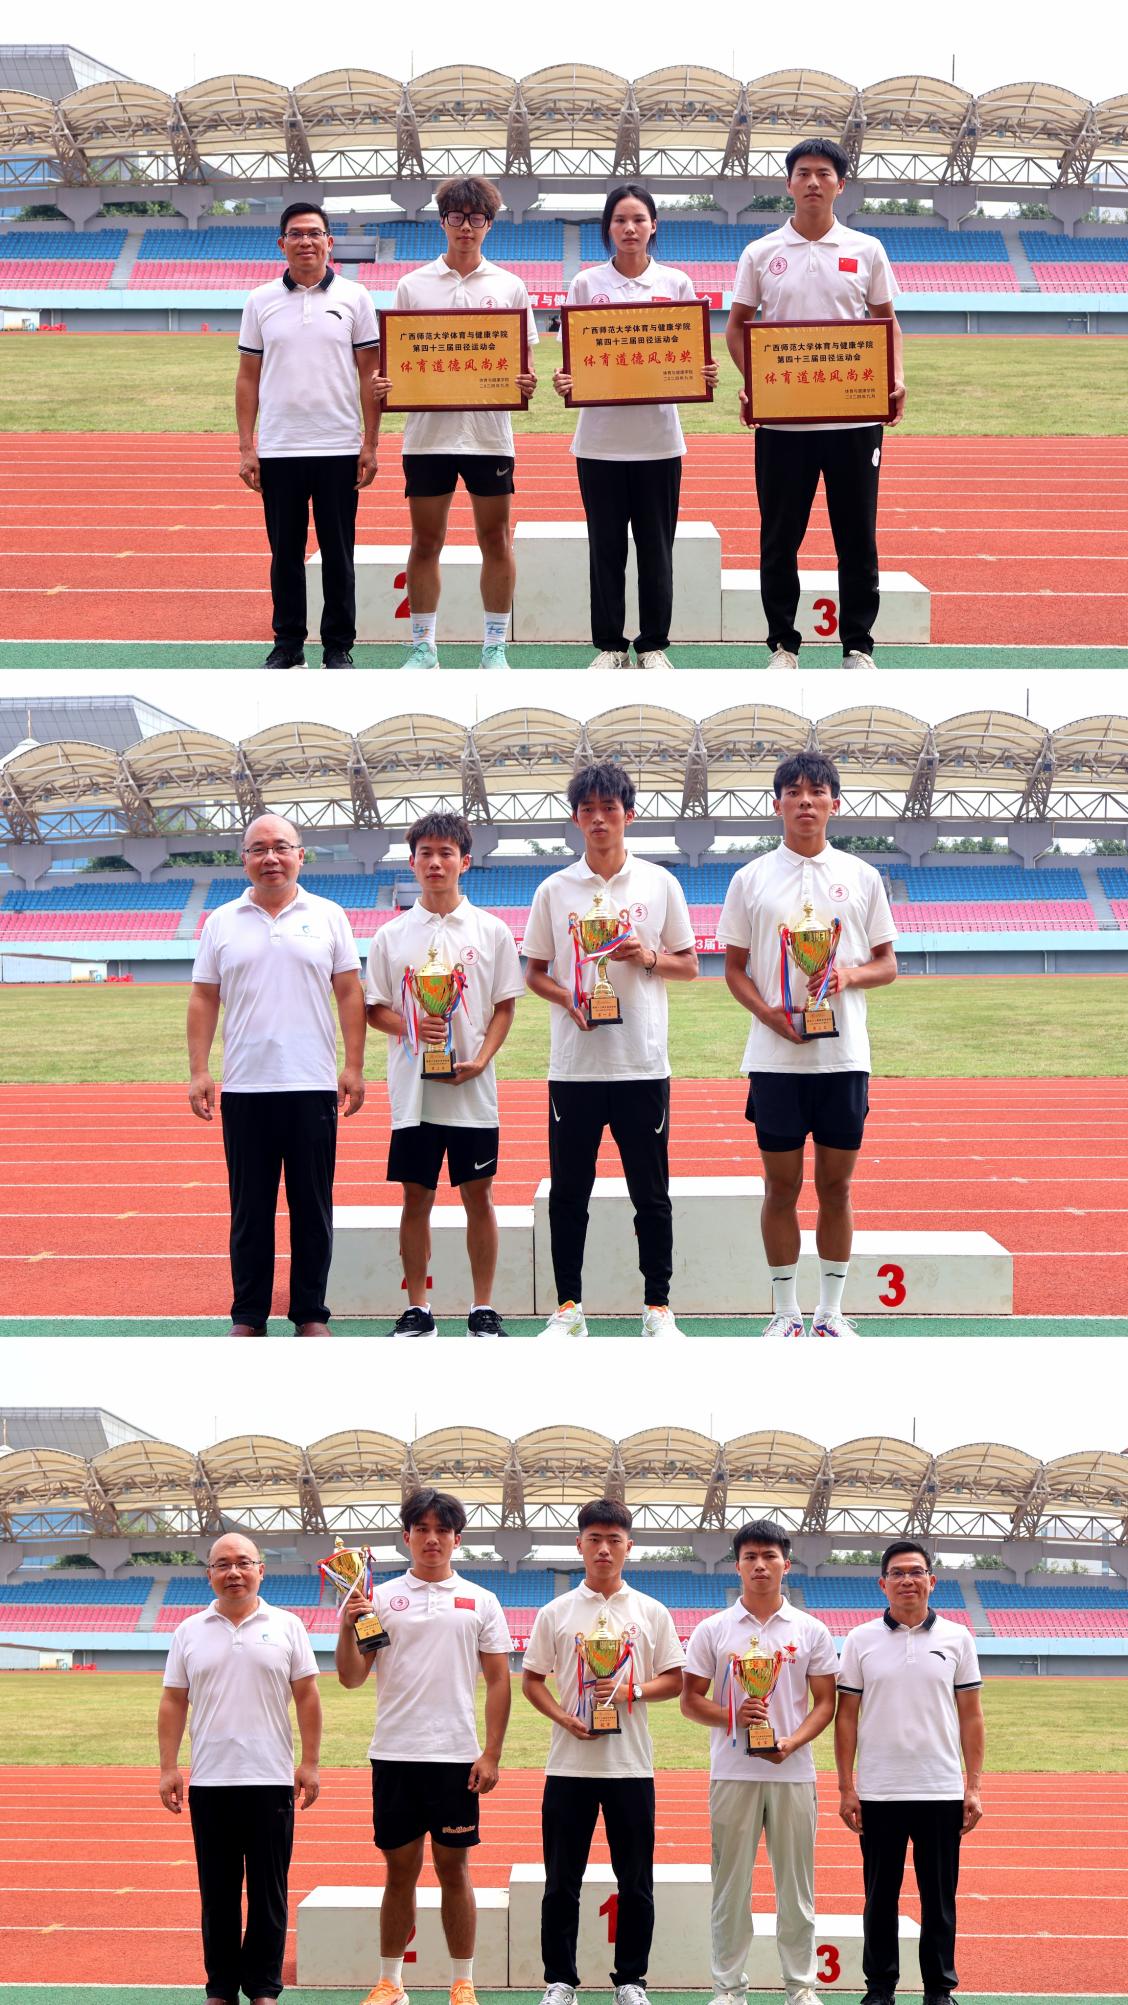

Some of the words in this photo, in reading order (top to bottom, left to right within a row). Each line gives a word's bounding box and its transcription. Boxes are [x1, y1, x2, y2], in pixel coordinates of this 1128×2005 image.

[400, 330, 508, 341] 广西师范大学体育与健康学院
[583, 322, 691, 336] 广西师范大学体育与健康学院
[412, 343, 496, 353] 第四十三届田径运动会
[596, 335, 679, 346] 第四十三届田径运动会
[764, 340, 874, 352] 广西师范大学体育与健康学院
[400, 357, 509, 374] 体育道德风尚奖
[584, 350, 692, 367] 体育道德风尚奖
[777, 353, 862, 364] 第四十三届田径运动会
[764, 367, 875, 385] 体育道德风尚奖
[812, 598, 839, 636] 3
[877, 1263, 907, 1308] 3
[599, 1893, 618, 1943] 1
[816, 1944, 841, 1983] 3
